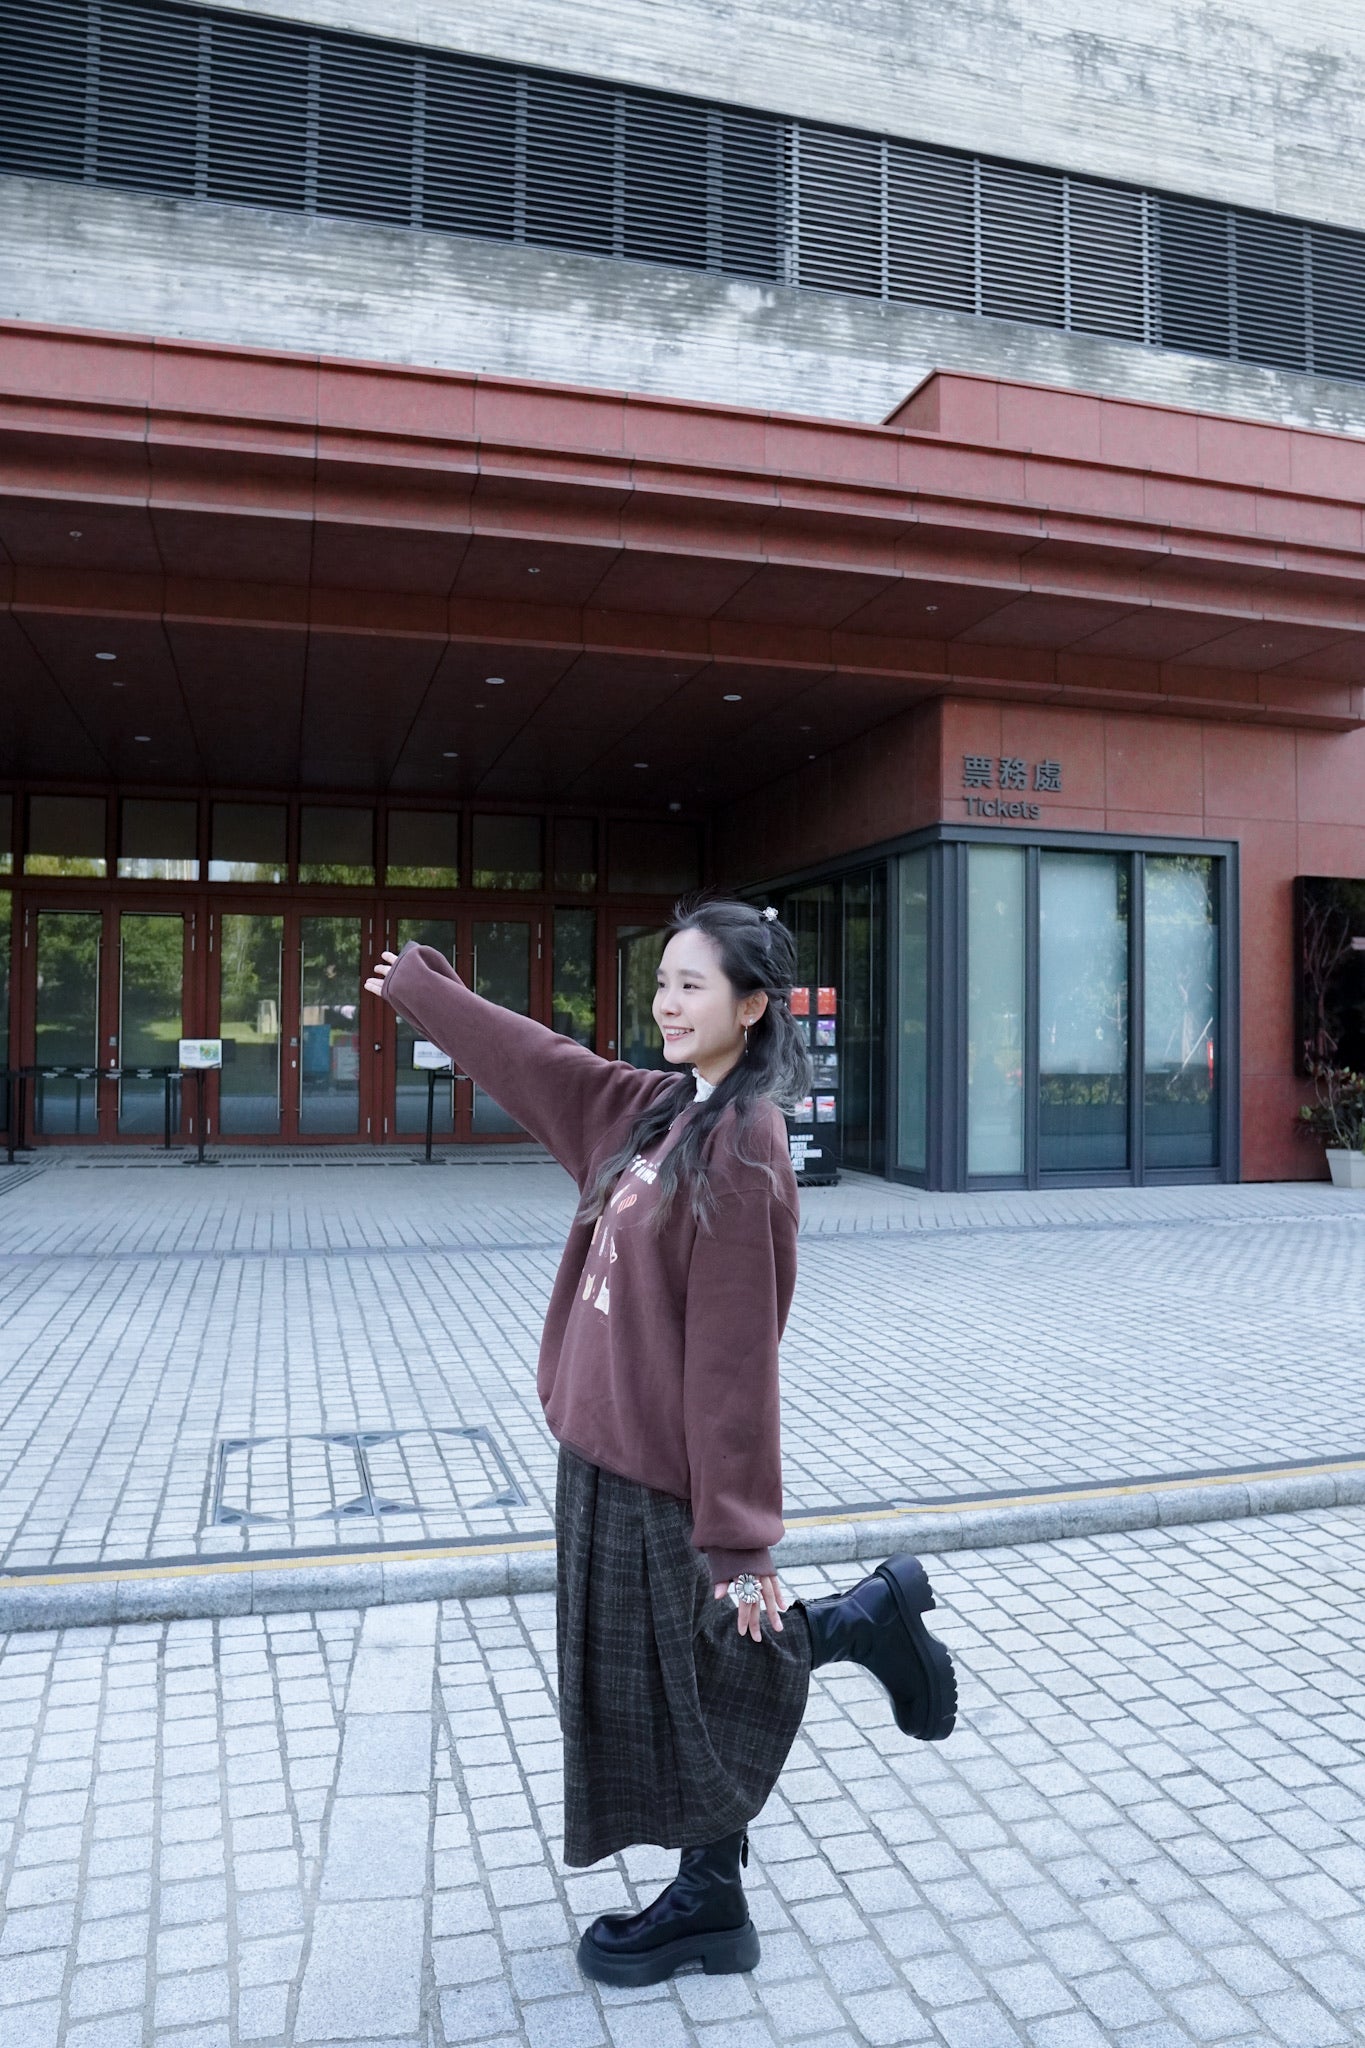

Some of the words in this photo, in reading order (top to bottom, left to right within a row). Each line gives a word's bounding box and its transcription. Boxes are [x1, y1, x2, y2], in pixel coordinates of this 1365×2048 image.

[963, 755, 1062, 792] 票務處
[963, 796, 1040, 819] Tickets
